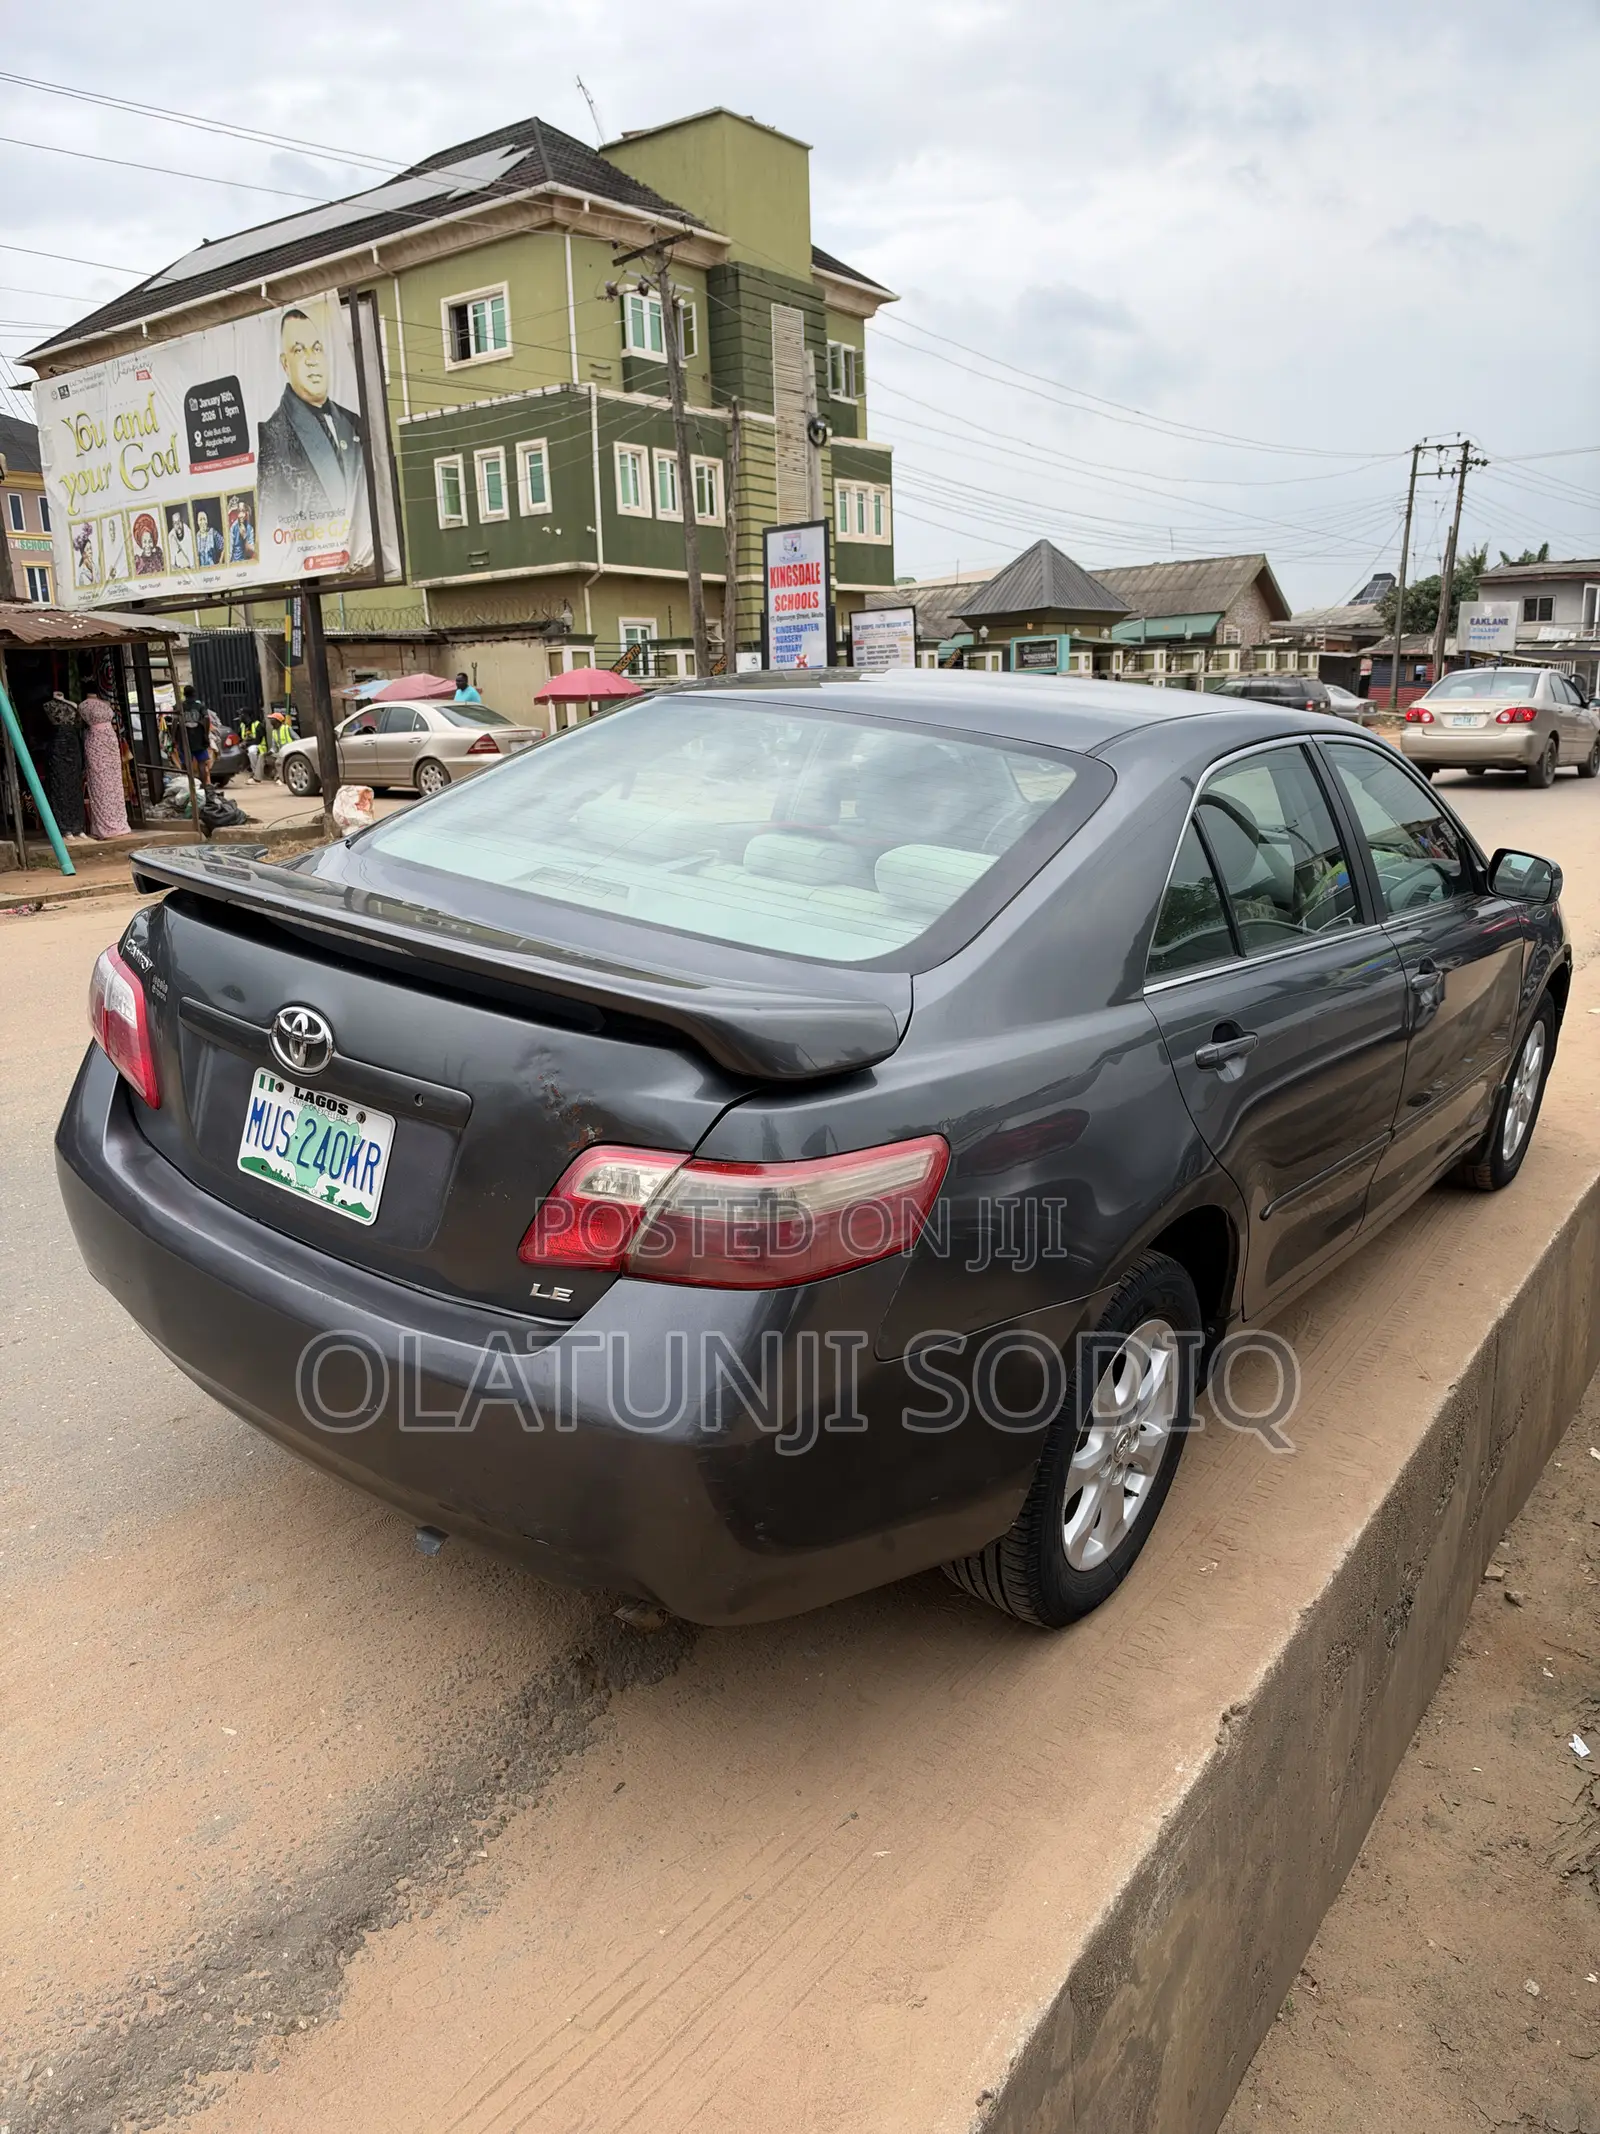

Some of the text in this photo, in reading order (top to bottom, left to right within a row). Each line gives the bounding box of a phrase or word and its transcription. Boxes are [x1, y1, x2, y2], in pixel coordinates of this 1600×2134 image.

[199, 396, 221, 408] January
[61, 391, 160, 457] You and
[201, 410, 217, 422] 2026
[57, 432, 181, 516] your God
[769, 562, 821, 589] KINGSDALE
[774, 591, 819, 612] SCHOOLS
[775, 623, 819, 635] KINDERGARTEN
[775, 635, 802, 644] NURSERY
[775, 644, 802, 654] PRIMARY
[293, 1086, 349, 1116] LAGOS
[529, 1283, 574, 1302] LE
